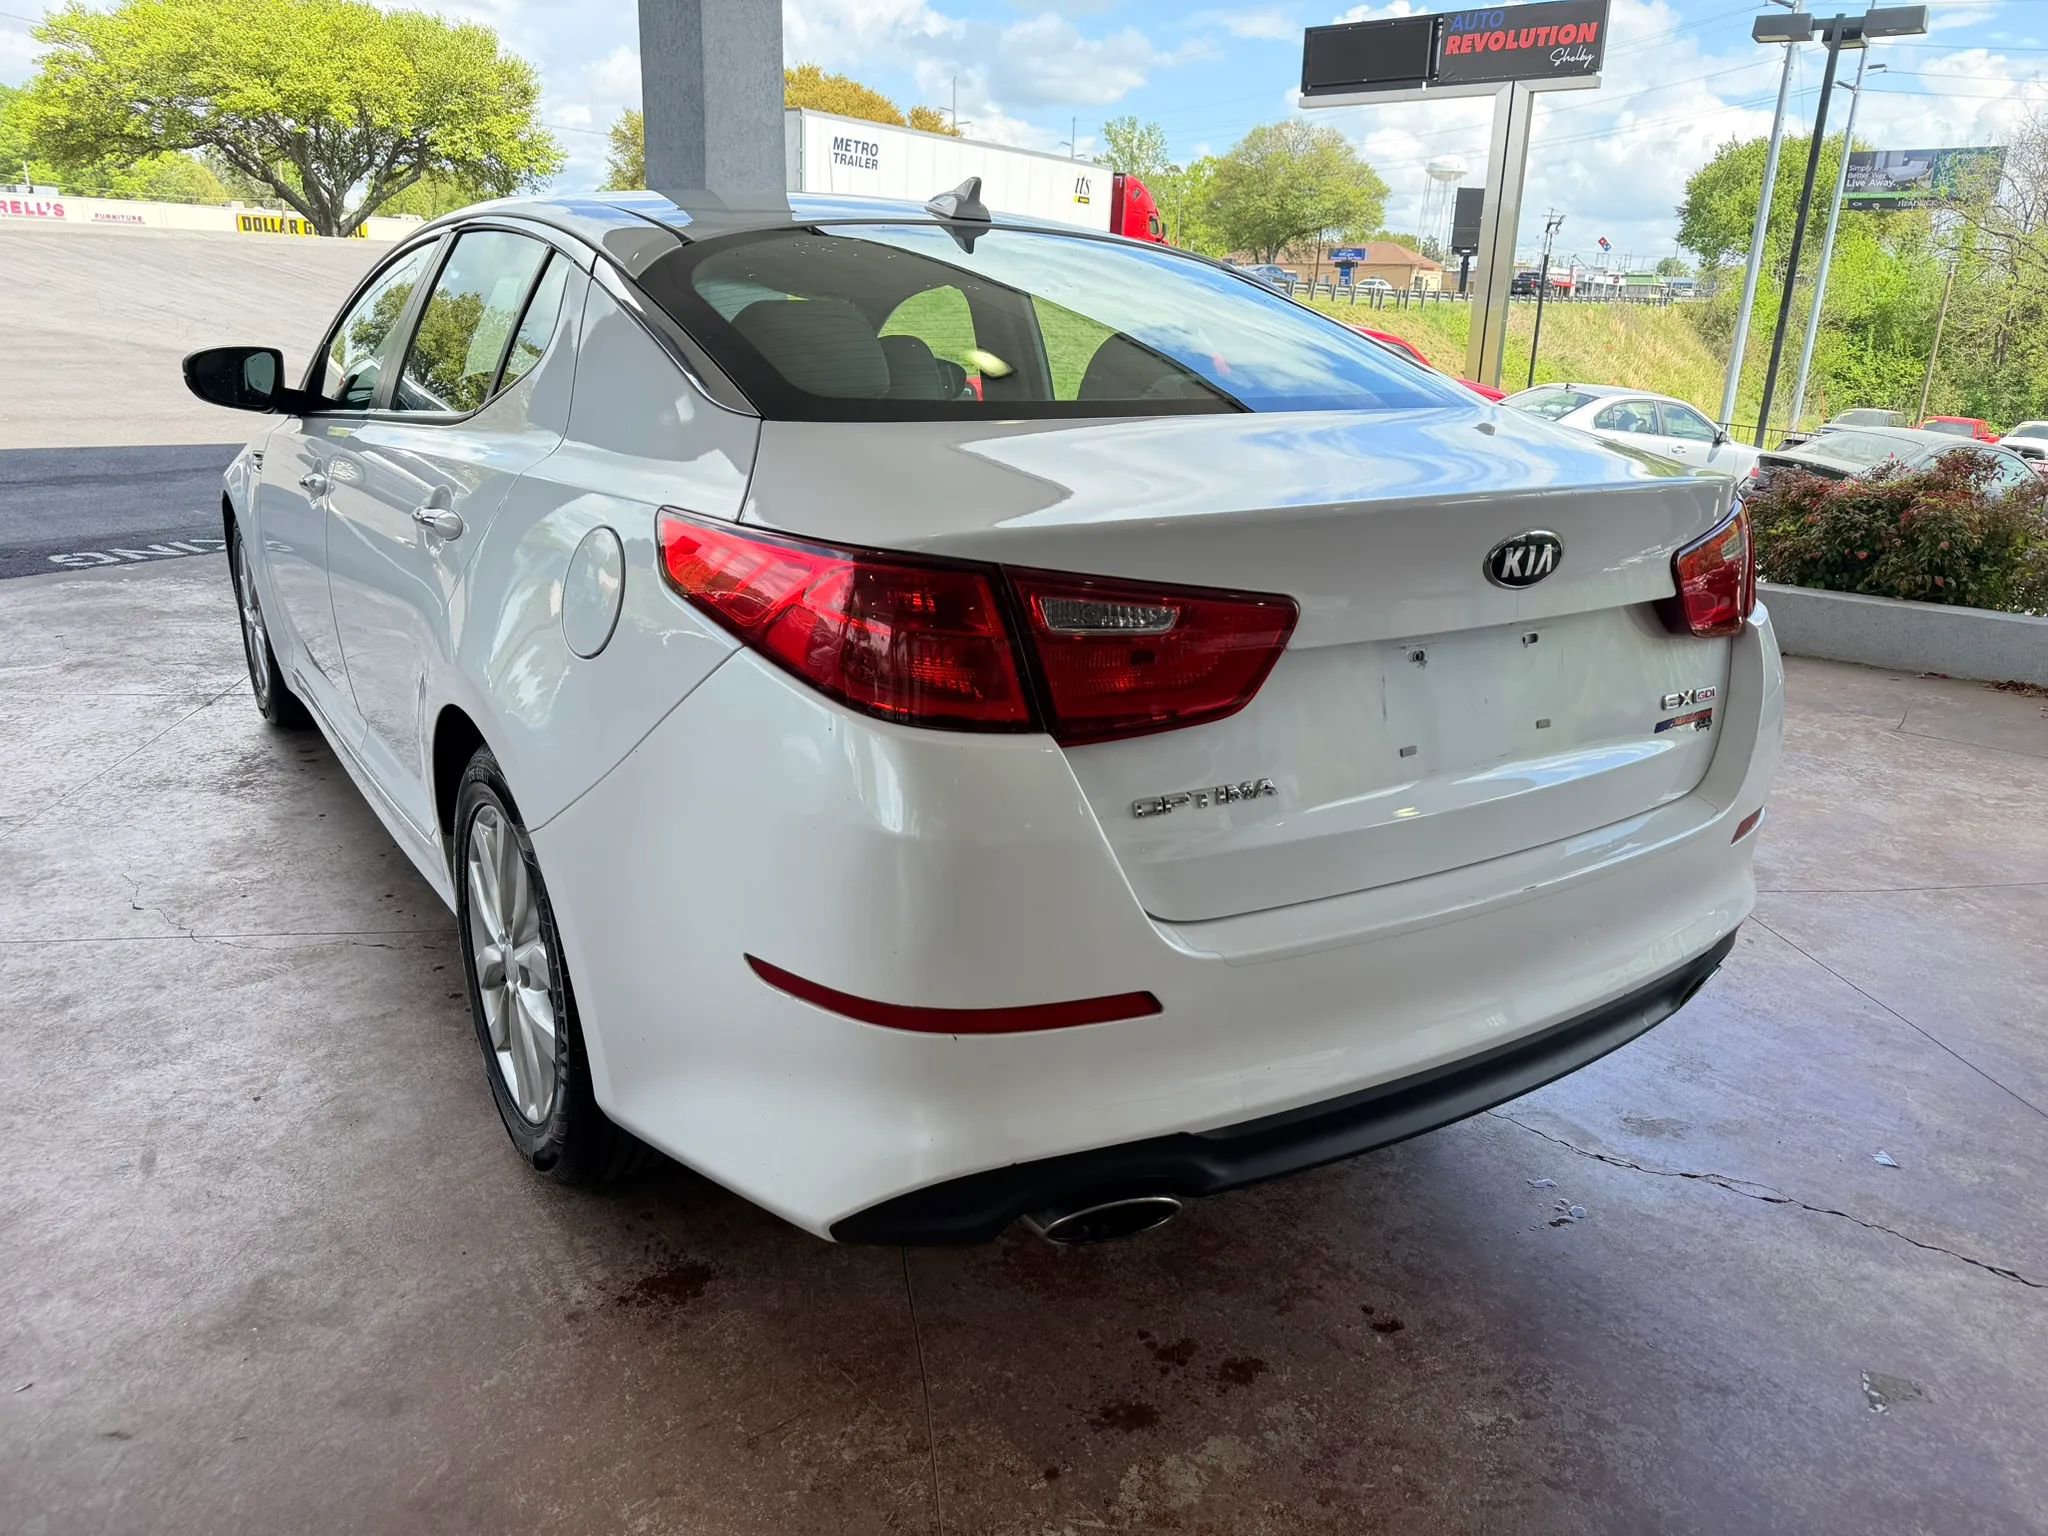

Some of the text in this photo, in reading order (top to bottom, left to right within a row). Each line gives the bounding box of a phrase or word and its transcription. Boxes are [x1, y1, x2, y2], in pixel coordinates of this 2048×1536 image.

[1451, 10, 1504, 32] AUTO
[1444, 22, 1600, 56] REVOLUTION
[1549, 45, 1595, 68] Shelby
[833, 136, 879, 157] METRO
[833, 152, 879, 171] TRAILER
[1846, 178, 1896, 188] Live Away.
[0, 200, 65, 217] RELL'S
[94, 212, 143, 222] FURNITURE
[241, 216, 299, 235] DOLLAR
[1500, 544, 1553, 578] KIA
[1661, 688, 1716, 711] EX GDI
[1132, 778, 1279, 817] OPTIMA
